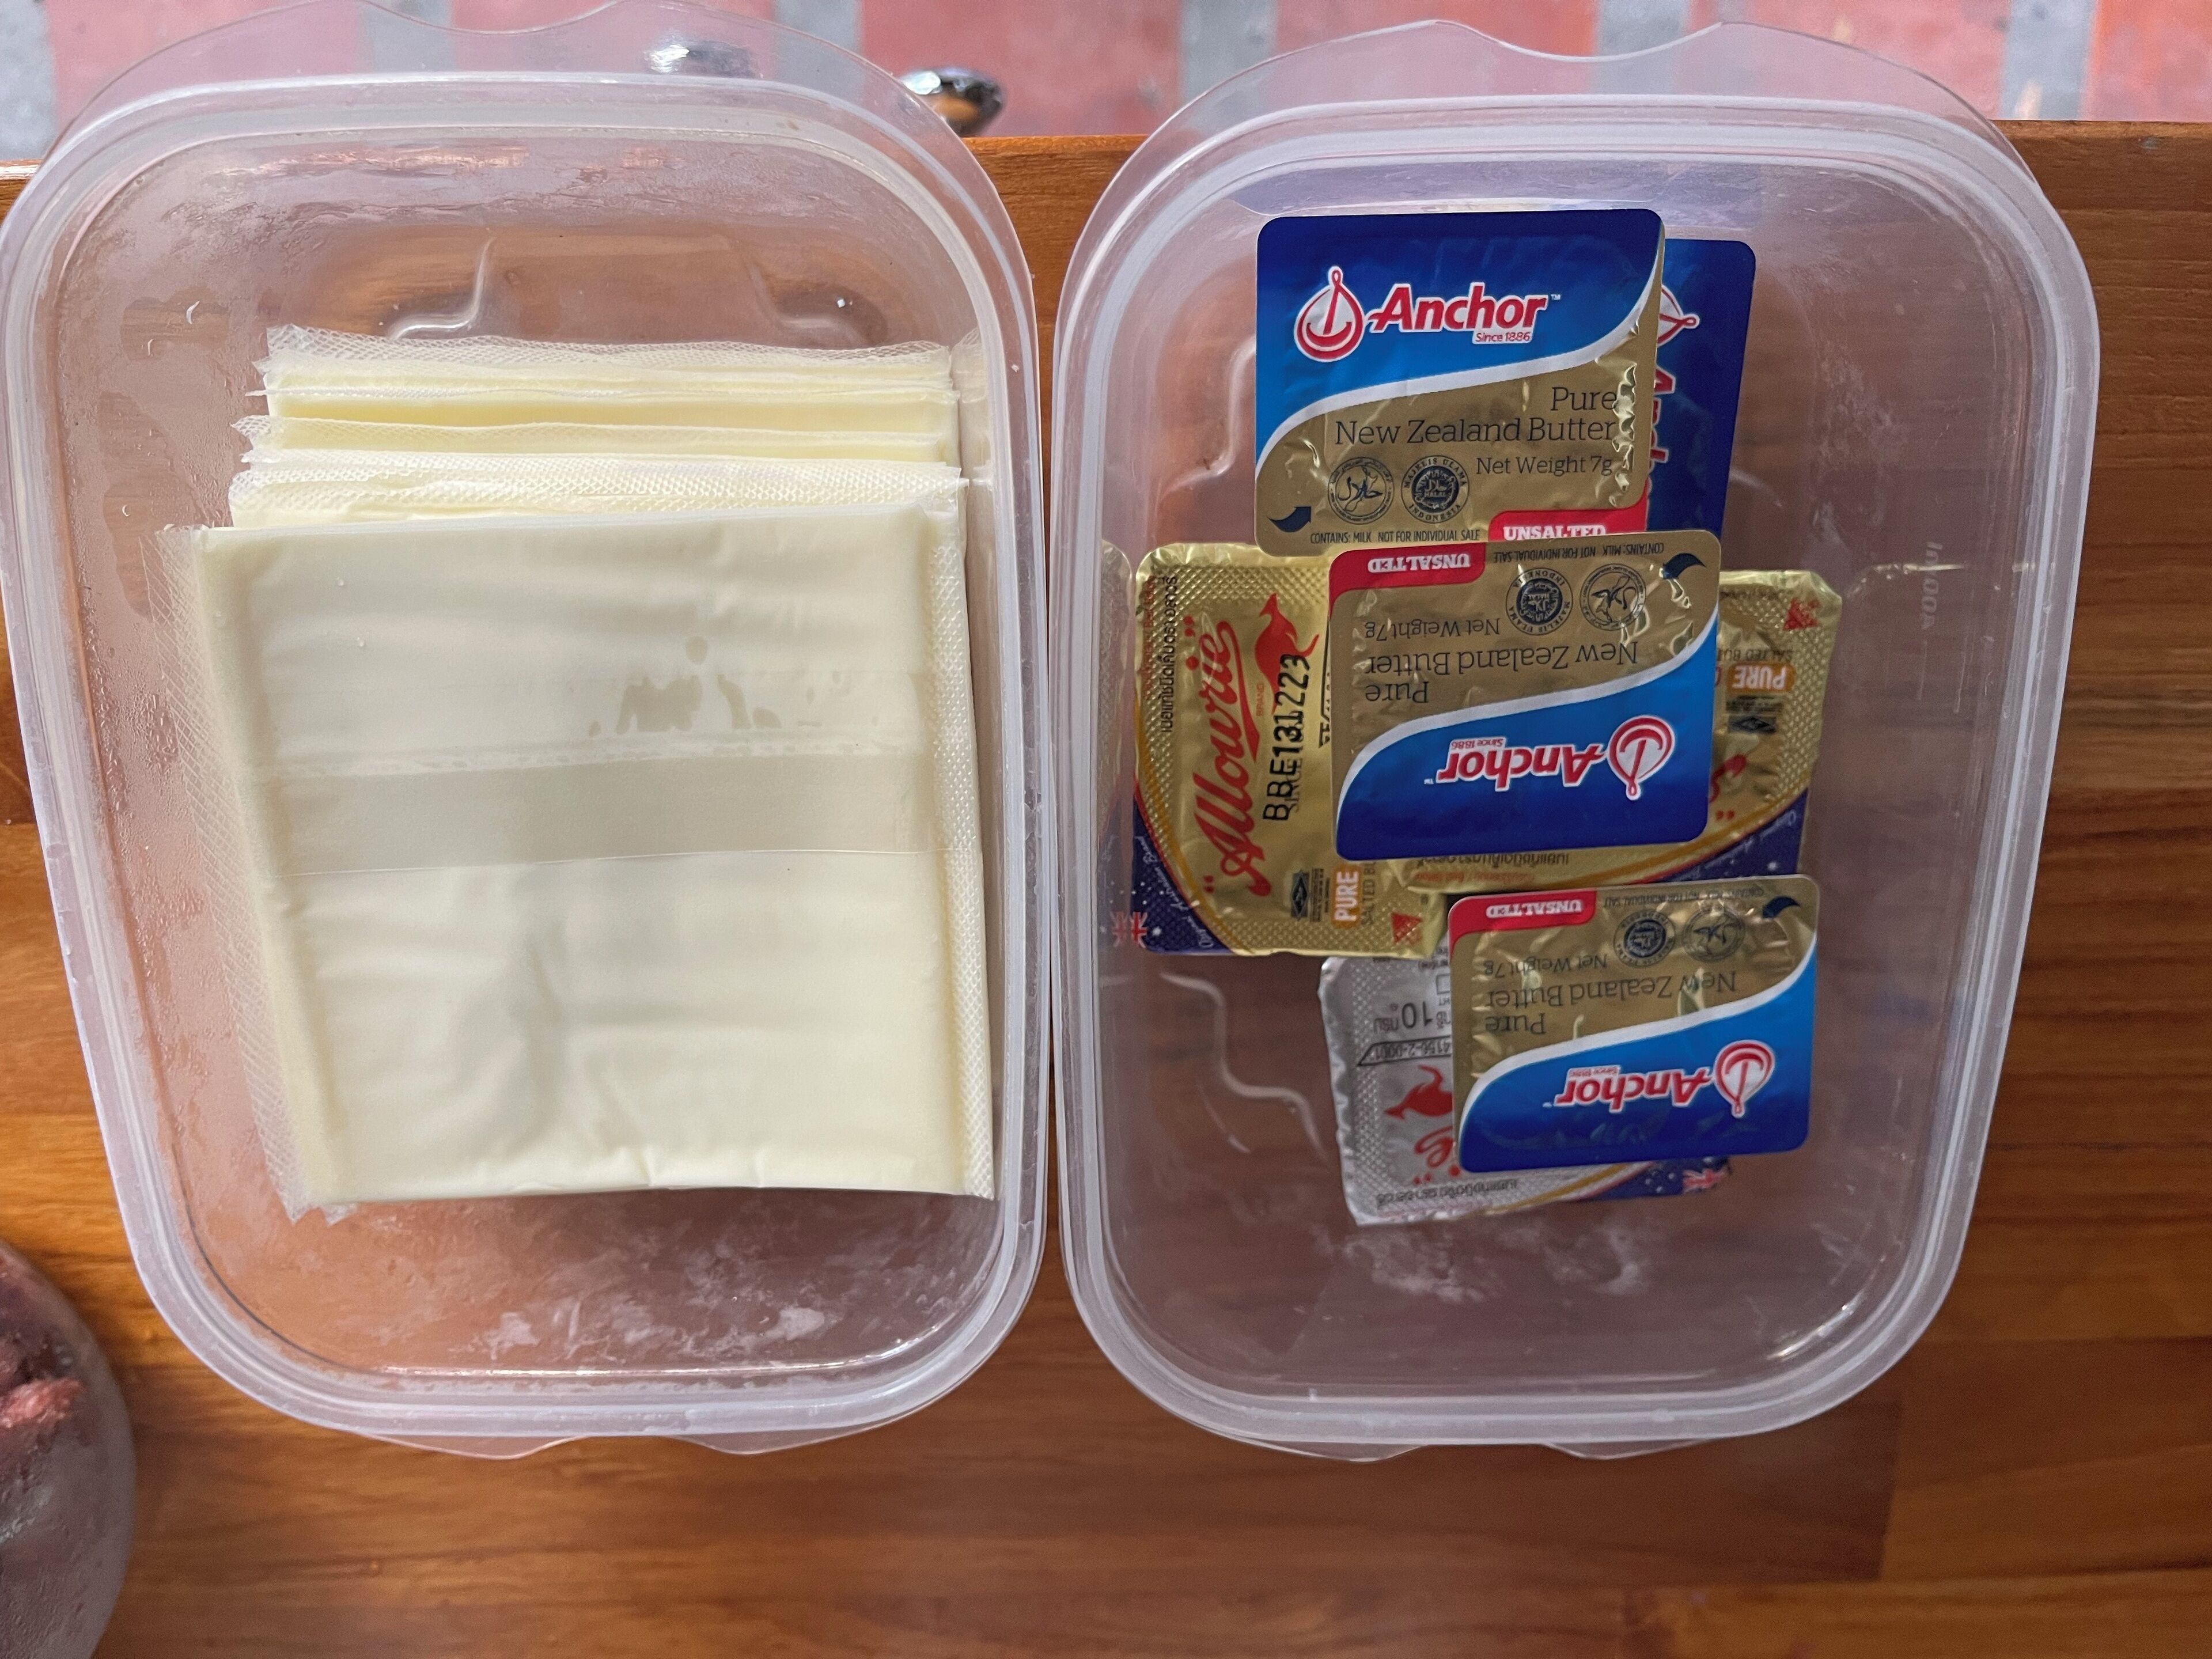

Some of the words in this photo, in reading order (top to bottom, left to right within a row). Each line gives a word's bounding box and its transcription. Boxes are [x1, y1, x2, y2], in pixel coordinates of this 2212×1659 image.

[1367, 284, 1548, 331] Anchor
[1475, 332, 1502, 342] Since
[1505, 332, 1530, 342] 1886
[1551, 387, 1617, 411] Pure
[1335, 421, 1400, 445] New
[1406, 418, 1521, 444] Zealand
[1527, 416, 1616, 441] Butter
[1476, 458, 1510, 475] Net
[1516, 456, 1588, 476] Weight
[1590, 455, 1613, 476] 7g
[1408, 503, 1461, 521] INDONESIA
[1310, 533, 1351, 544] CONTAINS:
[1353, 532, 1372, 543] MILK
[1377, 532, 1394, 543] NOT
[1396, 532, 1412, 542] FOR
[1413, 531, 1459, 542] INDIVIDUAL
[1460, 530, 1480, 541] SALE
[1502, 524, 1607, 540] UNSALTED
[1493, 551, 1513, 563] SALE
[1514, 548, 1560, 560] INDIVIDUAL
[1562, 548, 1578, 559] FOR
[1580, 547, 1596, 558] NOT
[1602, 546, 1622, 556] MILK
[1624, 543, 1664, 555] CONTAINS:
[1368, 553, 1471, 574] UNSALTED
[1365, 622, 1390, 642] 7g
[1392, 619, 1461, 638] Weight
[1468, 618, 1500, 635] Net
[1457, 645, 1569, 675] Zealand
[1576, 641, 1638, 665] New
[1365, 652, 1450, 676] Butter
[1732, 664, 1786, 690] PURE
[1255, 682, 1266, 718] BRAND
[1365, 681, 1429, 703] Pure
[1438, 744, 1605, 789] Anchor
[1334, 871, 1359, 922] PURE
[1486, 899, 1584, 919] UNSALTED
[1509, 955, 1572, 975] Weight
[1577, 955, 1608, 969] Net
[1569, 975, 1673, 1005] Zealand
[1679, 969, 1737, 993] New
[1487, 985, 1563, 1009] Butter
[1402, 1001, 1433, 1029] 10
[1485, 1012, 1547, 1035] Pure
[1556, 1070, 1711, 1110] Anchor
